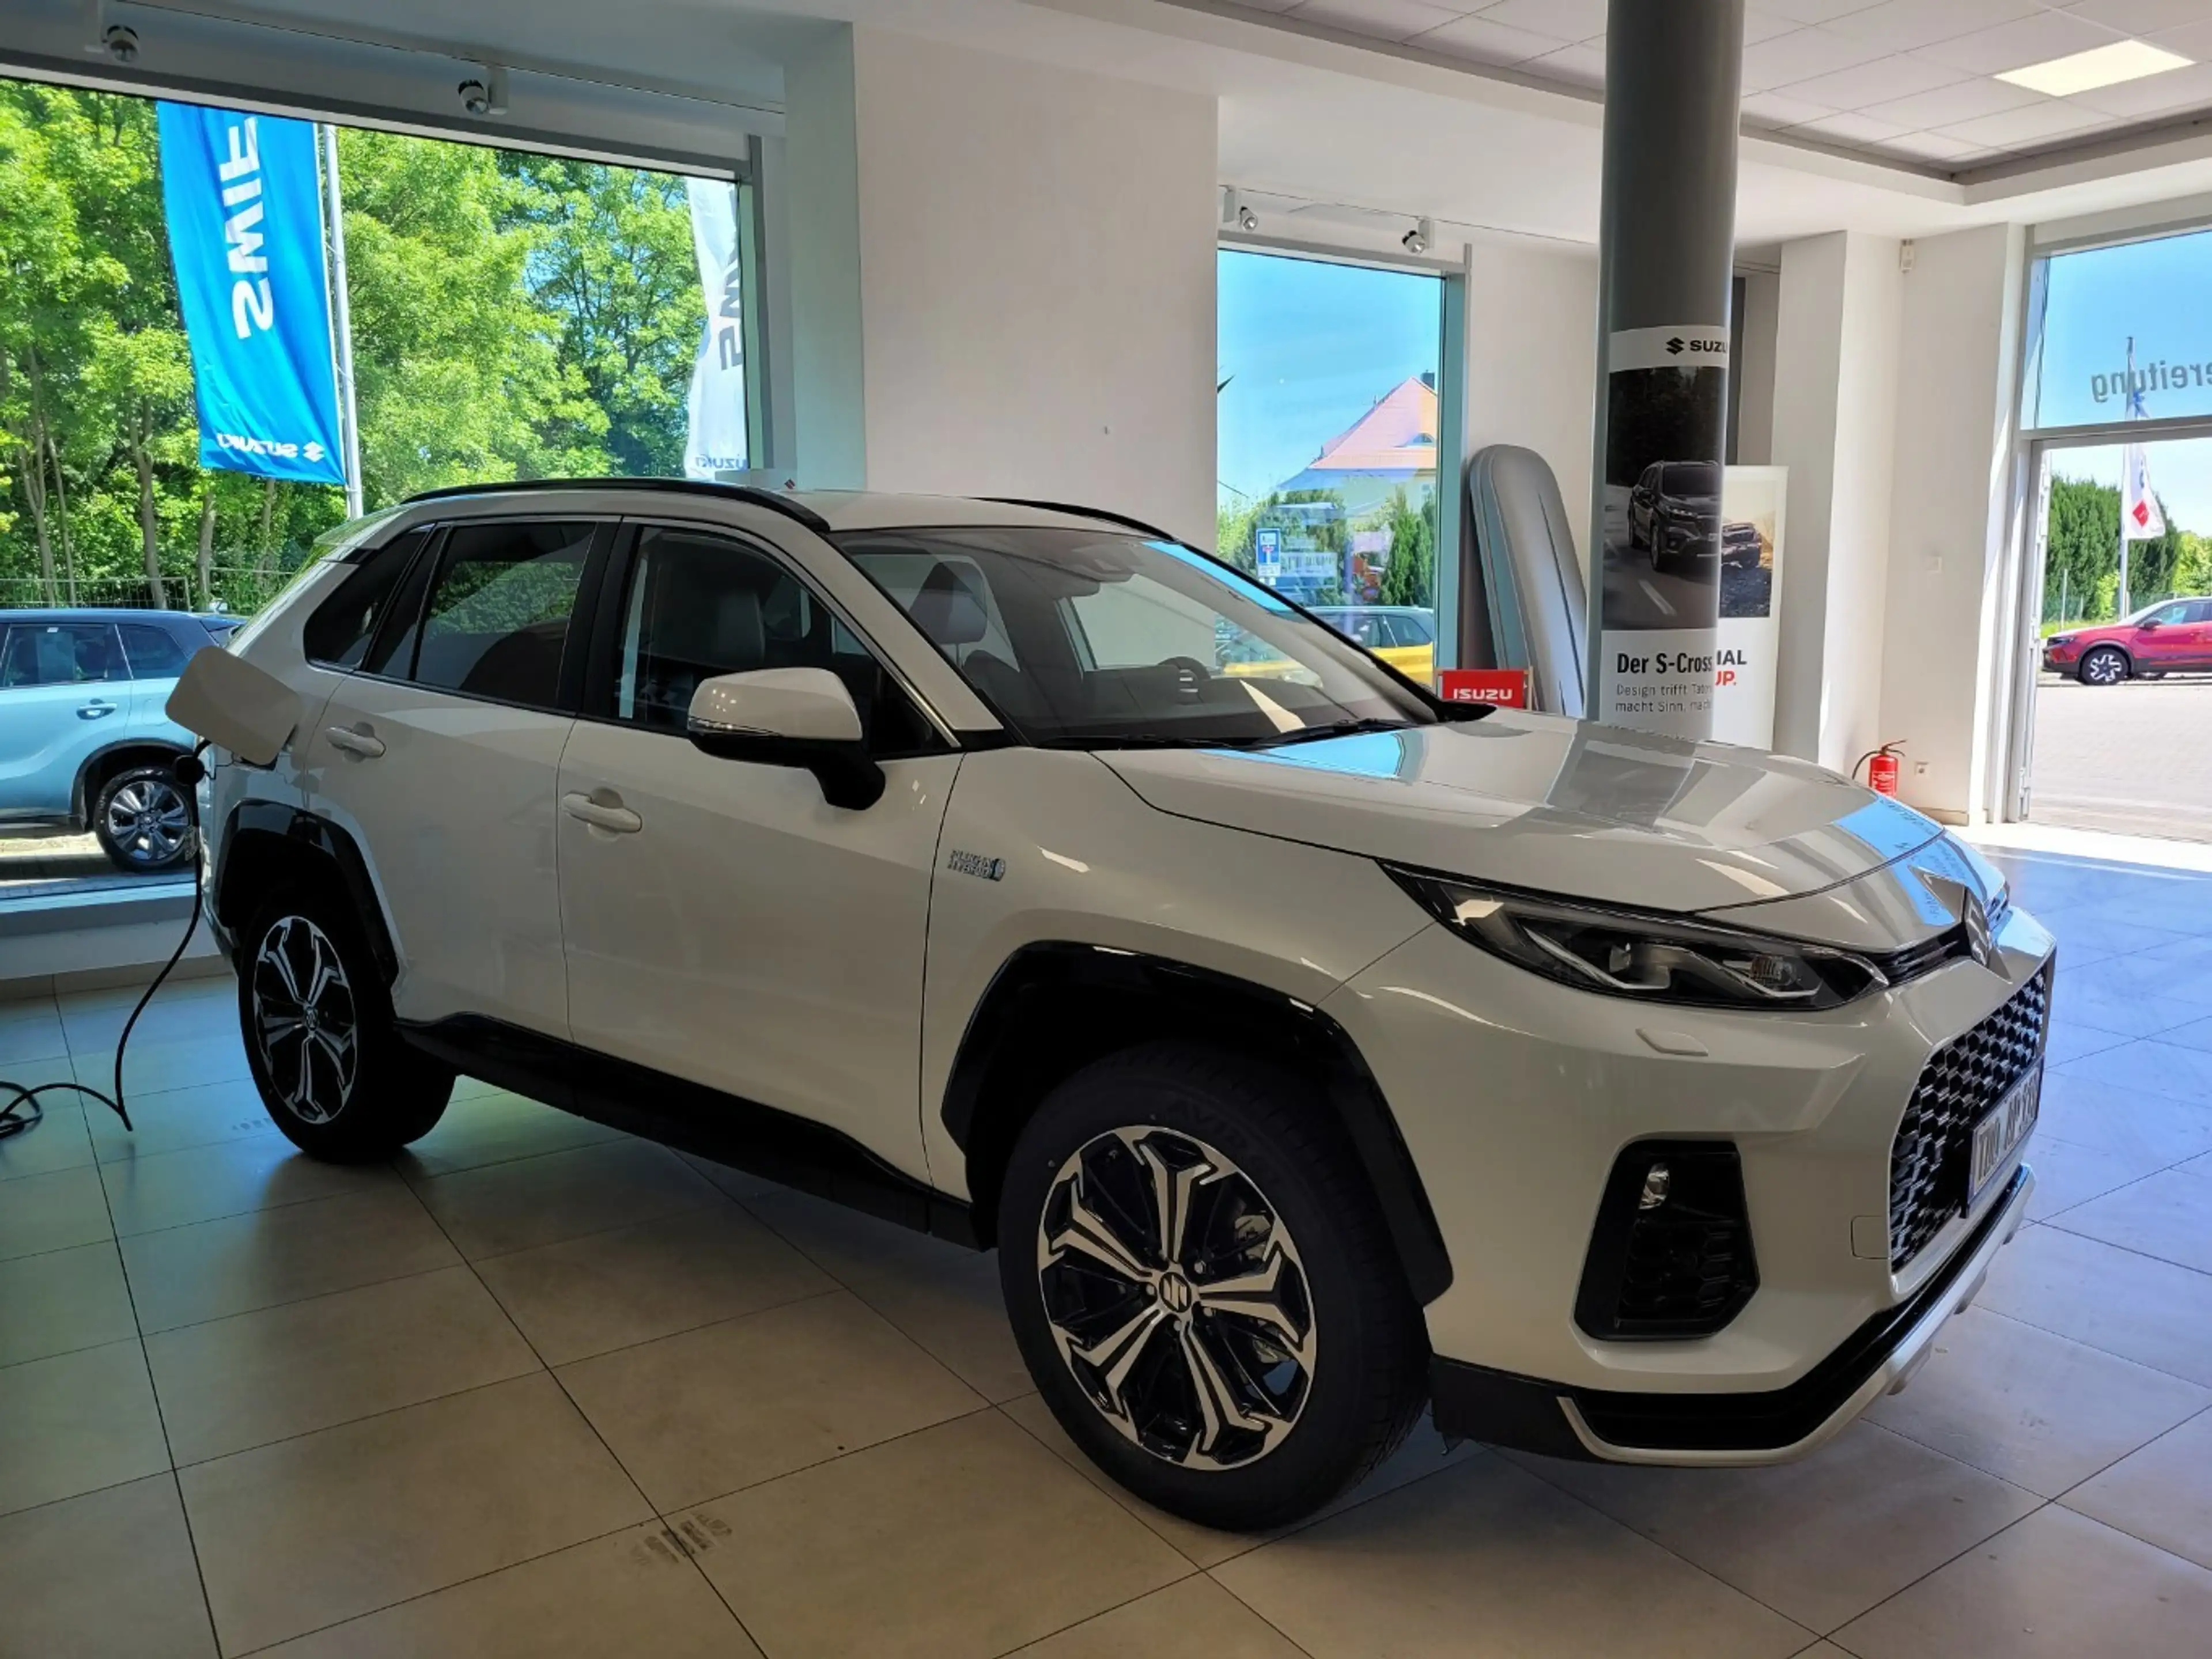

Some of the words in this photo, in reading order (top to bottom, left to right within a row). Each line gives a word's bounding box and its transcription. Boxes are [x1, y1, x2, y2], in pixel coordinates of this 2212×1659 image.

[1617, 653, 1649, 673] Der
[1655, 653, 1712, 674] S-Cross
[1453, 688, 1513, 700] ISUZU
[1617, 684, 1656, 698] Design
[1661, 684, 1687, 695] trifft
[1616, 700, 1654, 712] macht
